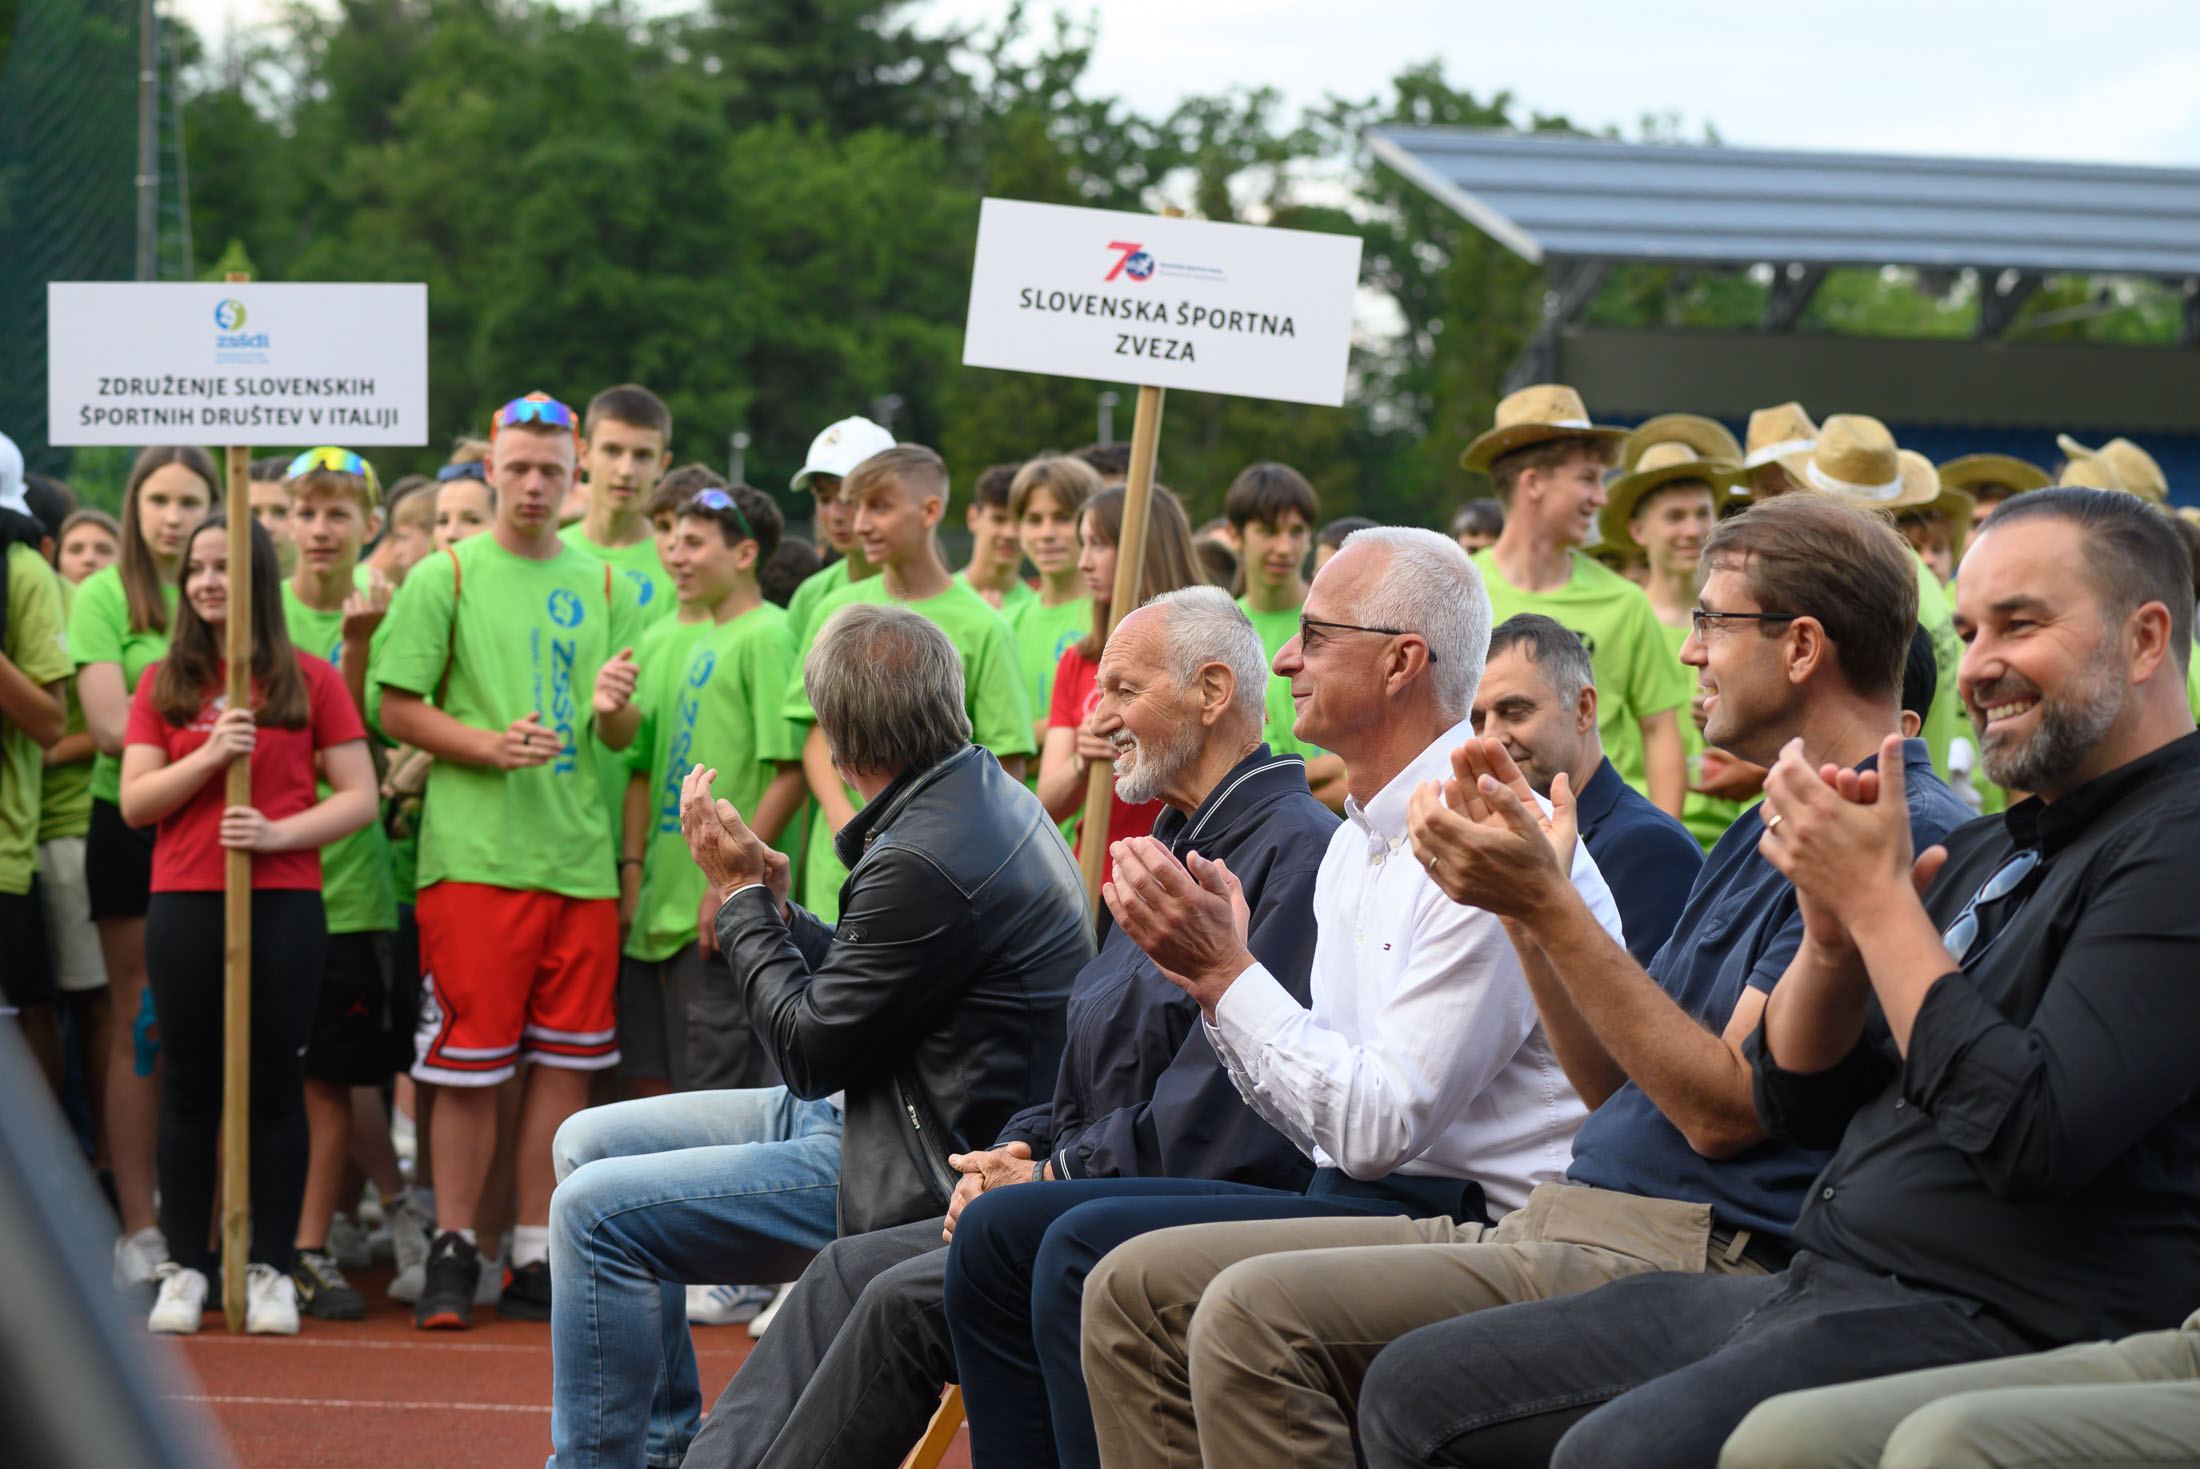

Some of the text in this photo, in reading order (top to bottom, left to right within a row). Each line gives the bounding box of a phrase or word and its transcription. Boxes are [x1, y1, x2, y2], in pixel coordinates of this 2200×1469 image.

[1019, 287, 1296, 338] SLOVENSKA ŠPORTNA
[1115, 333, 1196, 363] ZVEZA
[98, 375, 376, 399] ZDRUŽENJE SLOVENSKIH
[80, 404, 399, 430] ŠPORTNIH DRUŠTEV V ITALIJI
